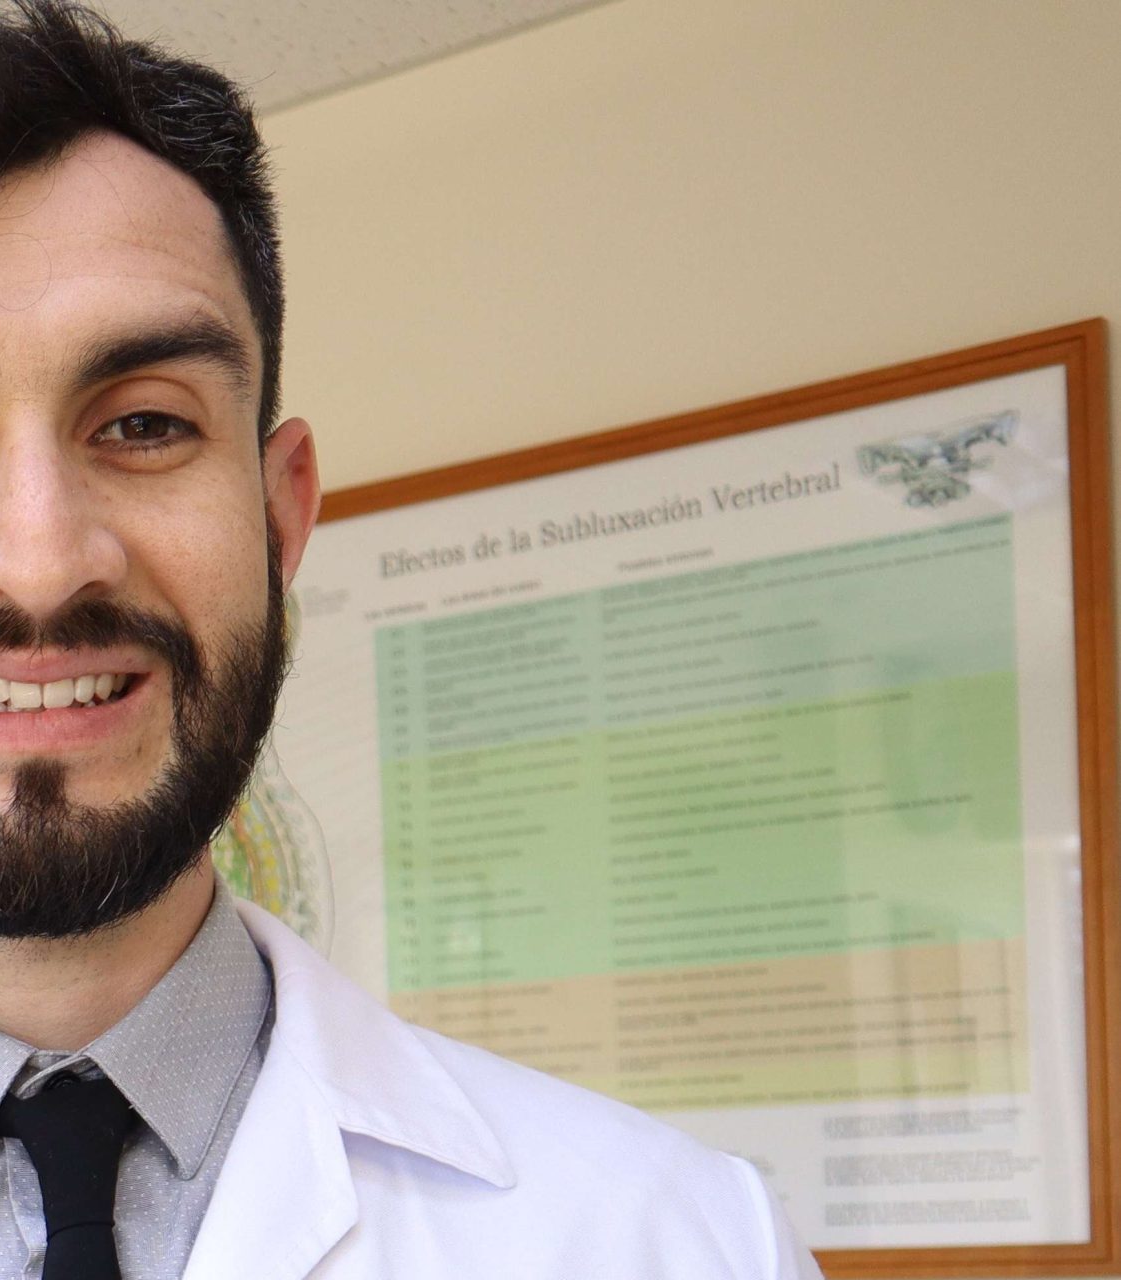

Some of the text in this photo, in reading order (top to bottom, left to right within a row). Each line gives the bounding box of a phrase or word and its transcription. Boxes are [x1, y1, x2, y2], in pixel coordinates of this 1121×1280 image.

[379, 461, 842, 581] Efectos de la Subluxación Vertebral
